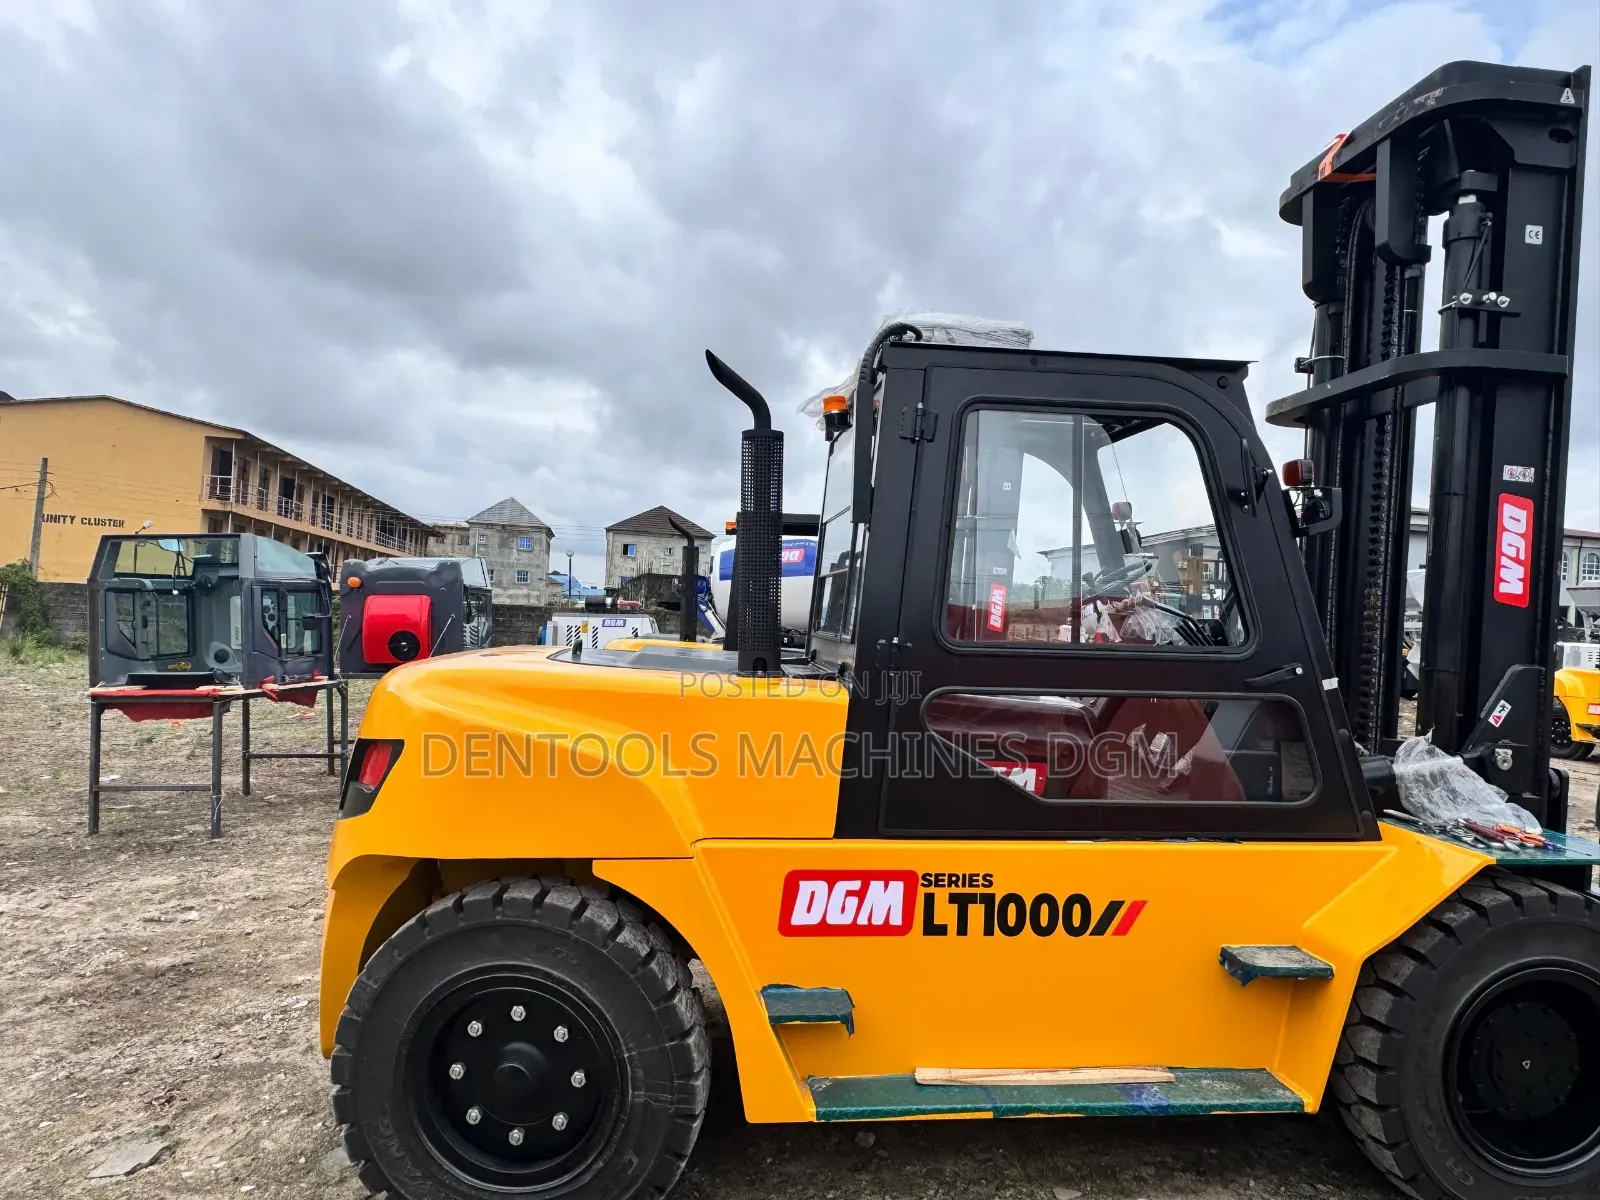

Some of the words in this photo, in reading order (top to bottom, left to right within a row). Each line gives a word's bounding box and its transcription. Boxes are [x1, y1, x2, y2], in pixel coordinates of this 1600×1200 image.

[41, 513, 76, 525] UNITY
[80, 516, 125, 528] CLUSTER
[1498, 502, 1528, 595] DGM
[603, 619, 624, 627] DGM
[989, 588, 1004, 628] DGM
[920, 872, 994, 888] SERIES
[790, 880, 905, 926] DGM
[922, 892, 1092, 937] LT1000
